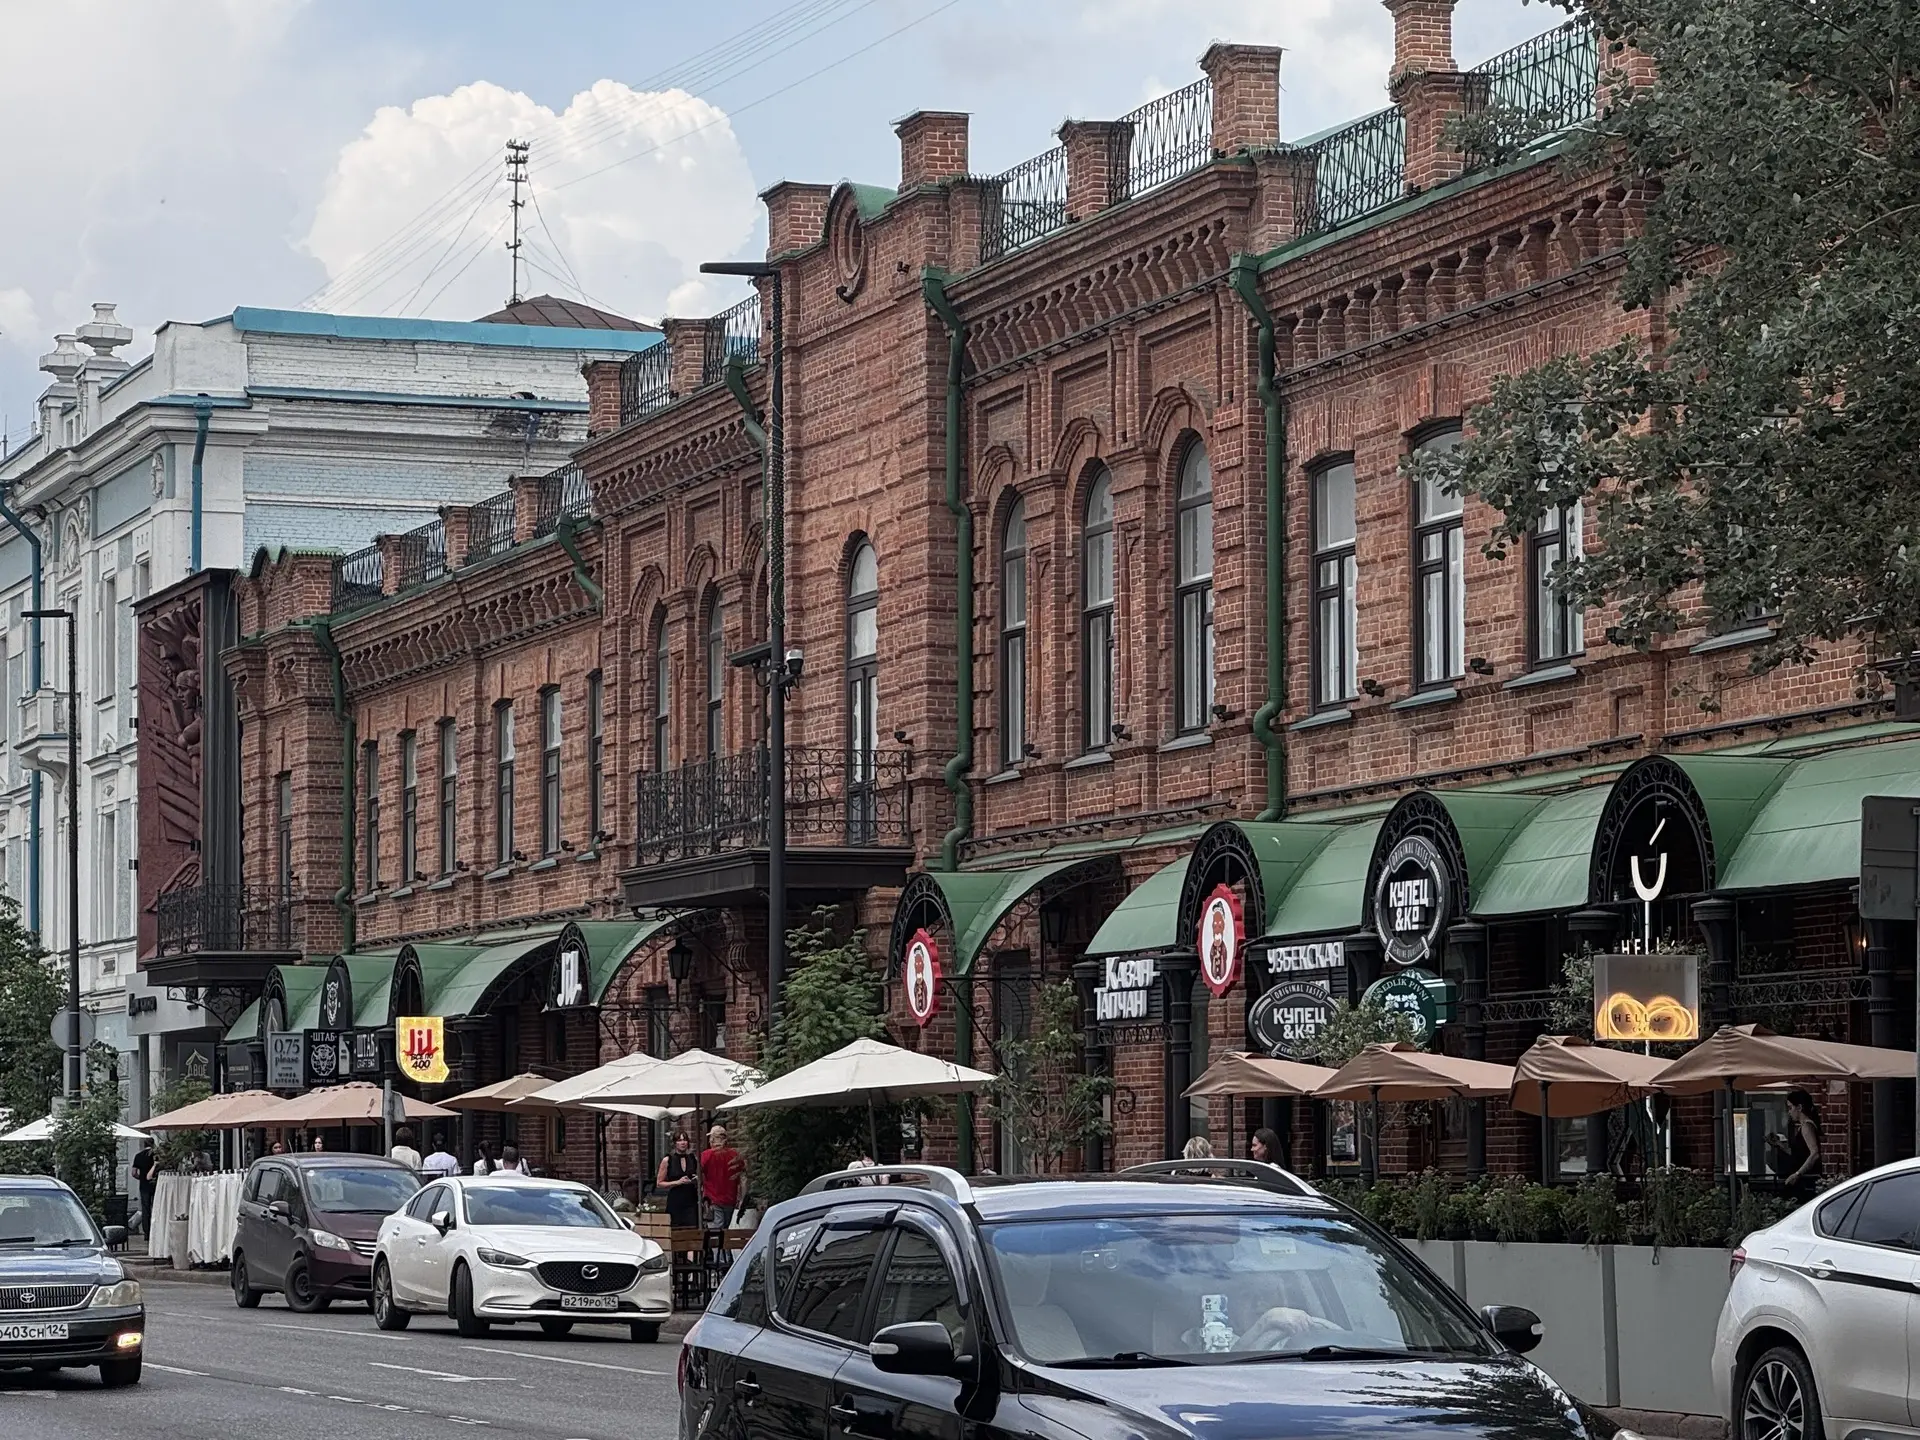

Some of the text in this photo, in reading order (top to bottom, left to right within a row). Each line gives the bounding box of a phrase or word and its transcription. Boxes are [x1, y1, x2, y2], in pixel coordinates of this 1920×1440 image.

[1391, 842, 1429, 866] ORIGINAL TASTE
[1389, 878, 1429, 908] КУПЕЦ
[1267, 941, 1344, 974] УЗБЕКСКАЯ
[1273, 984, 1304, 999] ORIGINAL
[1305, 984, 1325, 998] TASTE
[1273, 1007, 1327, 1025] КУПЕЦ
[312, 1031, 336, 1042] ШТАБ
[274, 1038, 300, 1054] 0.75
[356, 1033, 375, 1058] ШТАБ
[274, 1055, 299, 1067] please
[412, 1060, 430, 1069] 400
[602, 1296, 617, 1306] 124
[46, 1323, 67, 1337] 124
